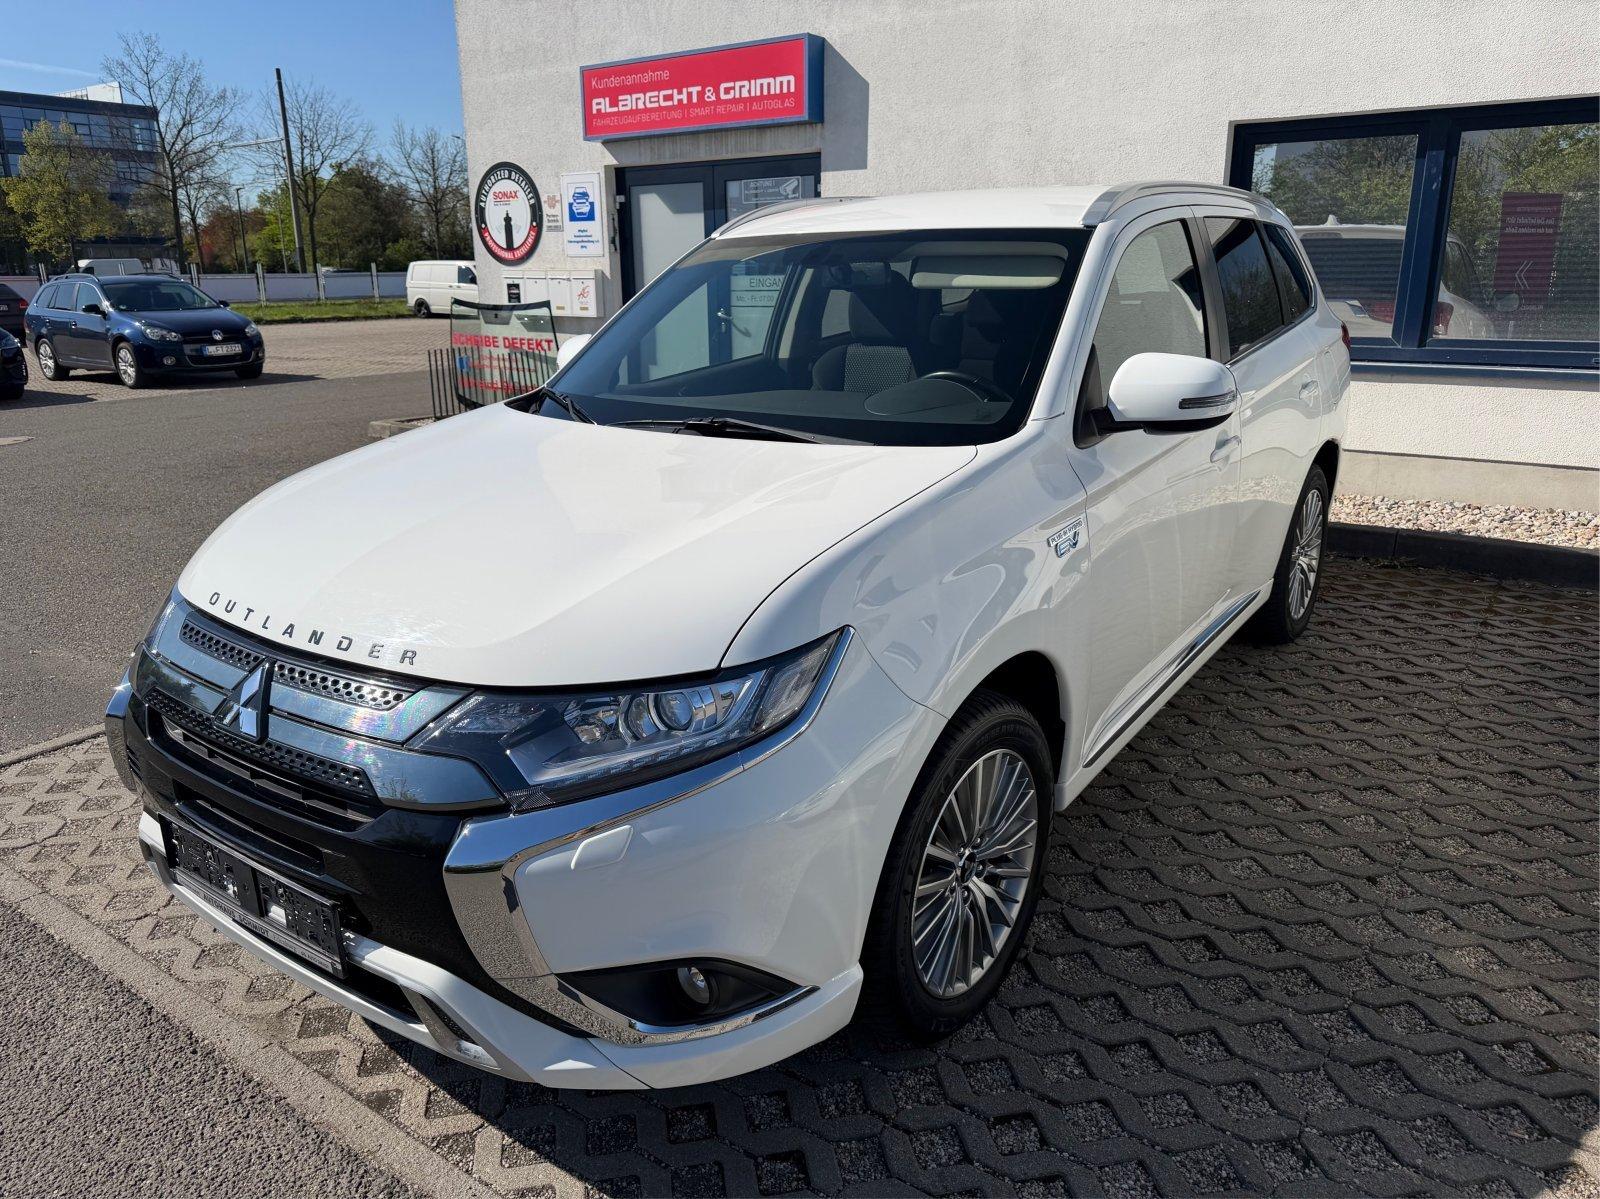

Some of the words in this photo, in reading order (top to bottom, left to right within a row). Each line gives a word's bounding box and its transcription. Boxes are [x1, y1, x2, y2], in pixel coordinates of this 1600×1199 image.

[591, 69, 670, 89] Kundenannahme
[592, 86, 702, 114] ALBRECHT
[704, 86, 716, 101] &
[719, 75, 795, 100] GRIMM
[592, 109, 682, 127] FAHRZEUGAUFBEREITUNG
[689, 106, 714, 118] SMART
[716, 103, 745, 114] REPAIR
[752, 97, 795, 111] AUTOGLAS
[479, 169, 509, 208] AUTHORIZED
[510, 171, 535, 205] DETAILER
[492, 190, 519, 200] SONAX
[452, 331, 500, 349] SCHEIBE
[502, 336, 554, 352] DEFEKT
[208, 591, 418, 666] OUTLANDER
